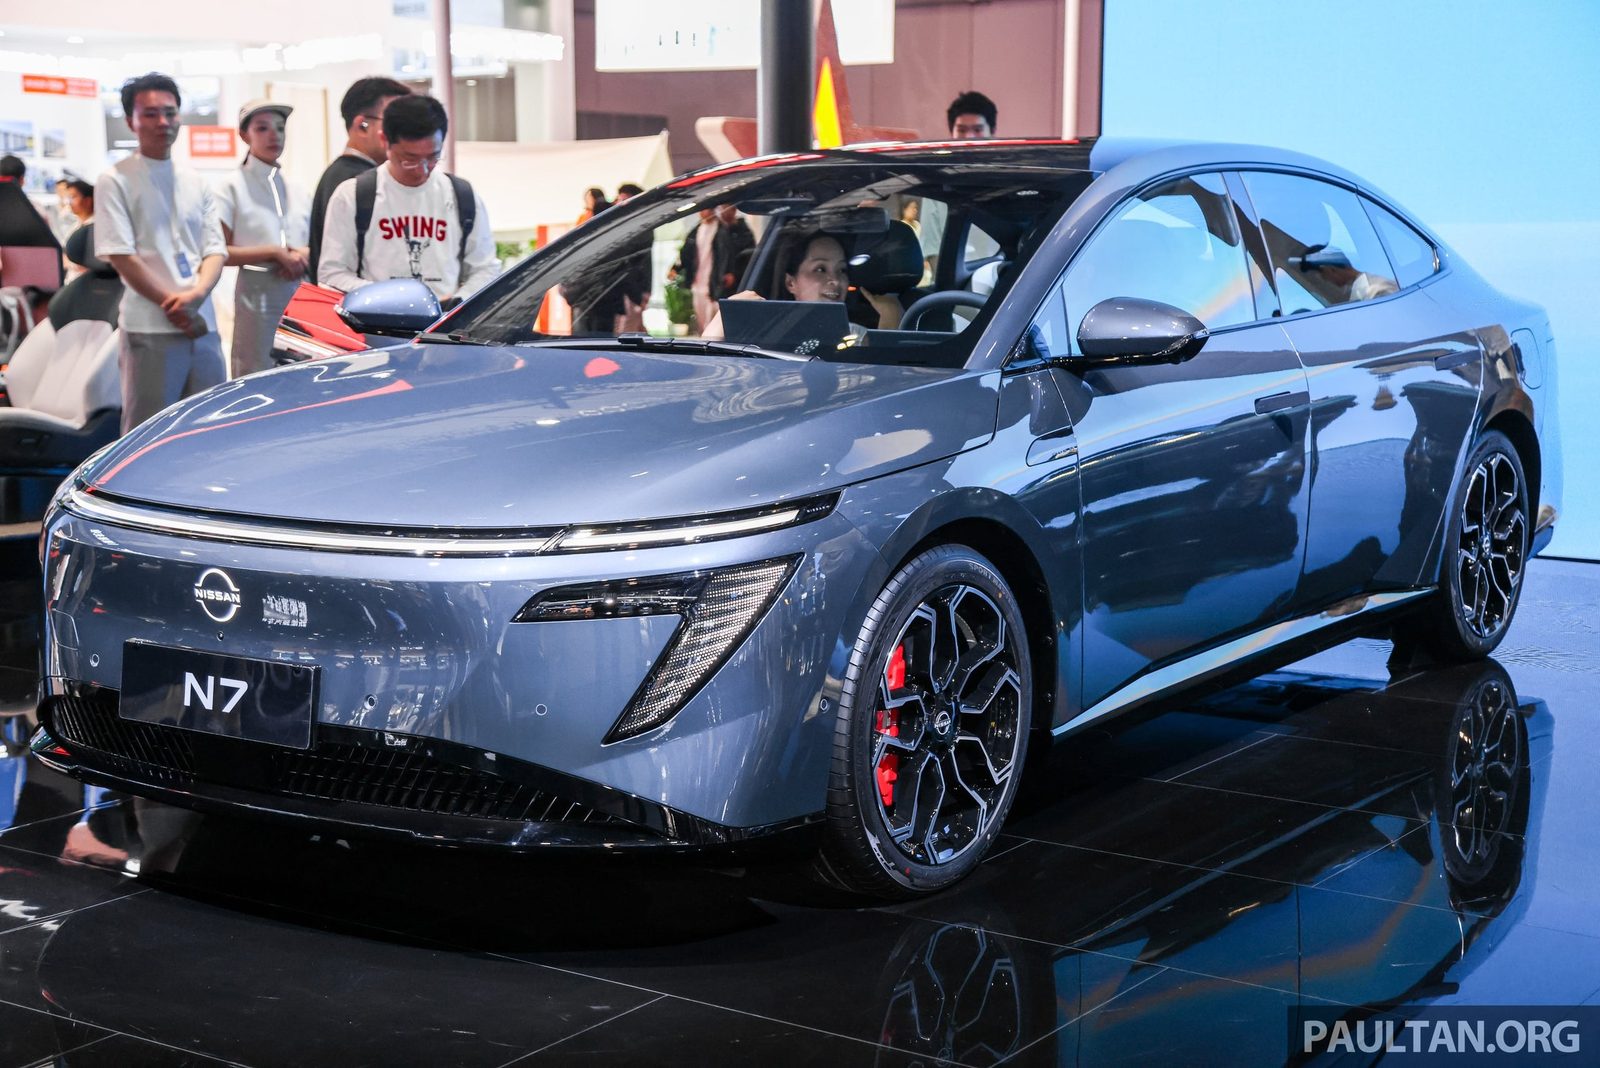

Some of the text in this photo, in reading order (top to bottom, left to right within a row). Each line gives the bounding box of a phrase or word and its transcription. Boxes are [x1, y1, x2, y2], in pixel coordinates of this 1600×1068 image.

[379, 216, 447, 242] SWING
[194, 587, 241, 604] NISSAN
[183, 671, 249, 714] N7
